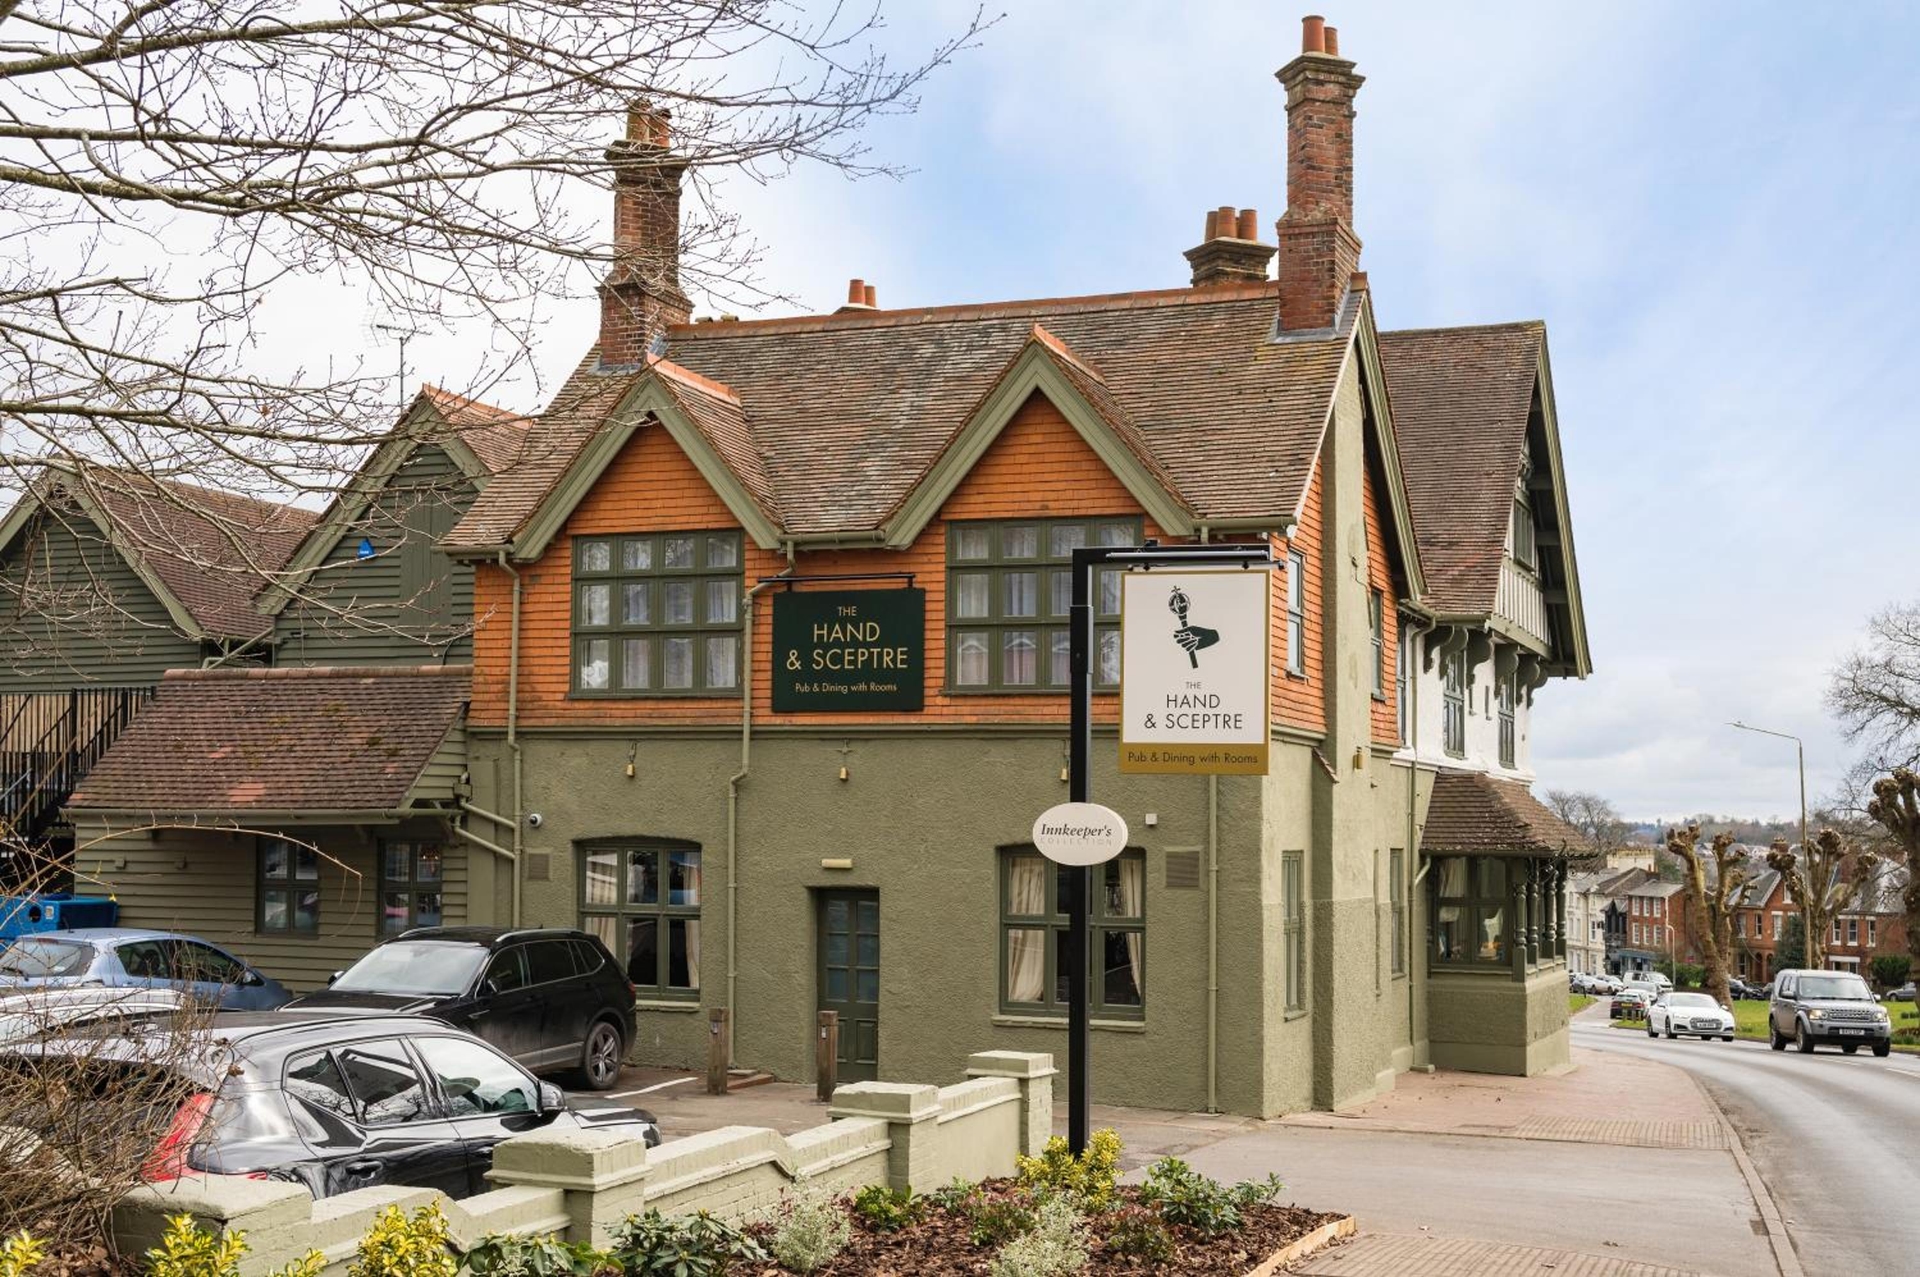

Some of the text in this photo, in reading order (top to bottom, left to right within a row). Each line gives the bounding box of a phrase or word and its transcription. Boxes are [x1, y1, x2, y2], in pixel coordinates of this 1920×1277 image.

[838, 606, 857, 616] THE
[813, 622, 880, 642] HAND
[786, 648, 908, 671] & SCEPTRE
[795, 682, 897, 694] Pub & Dining with Rooms
[1185, 681, 1202, 689] THE
[1166, 694, 1220, 709] HAND
[1144, 713, 1243, 729] & SCEPTRE
[1128, 752, 1258, 765] Pub & Dining with Rooms
[1041, 824, 1112, 838] Innkeeper's
